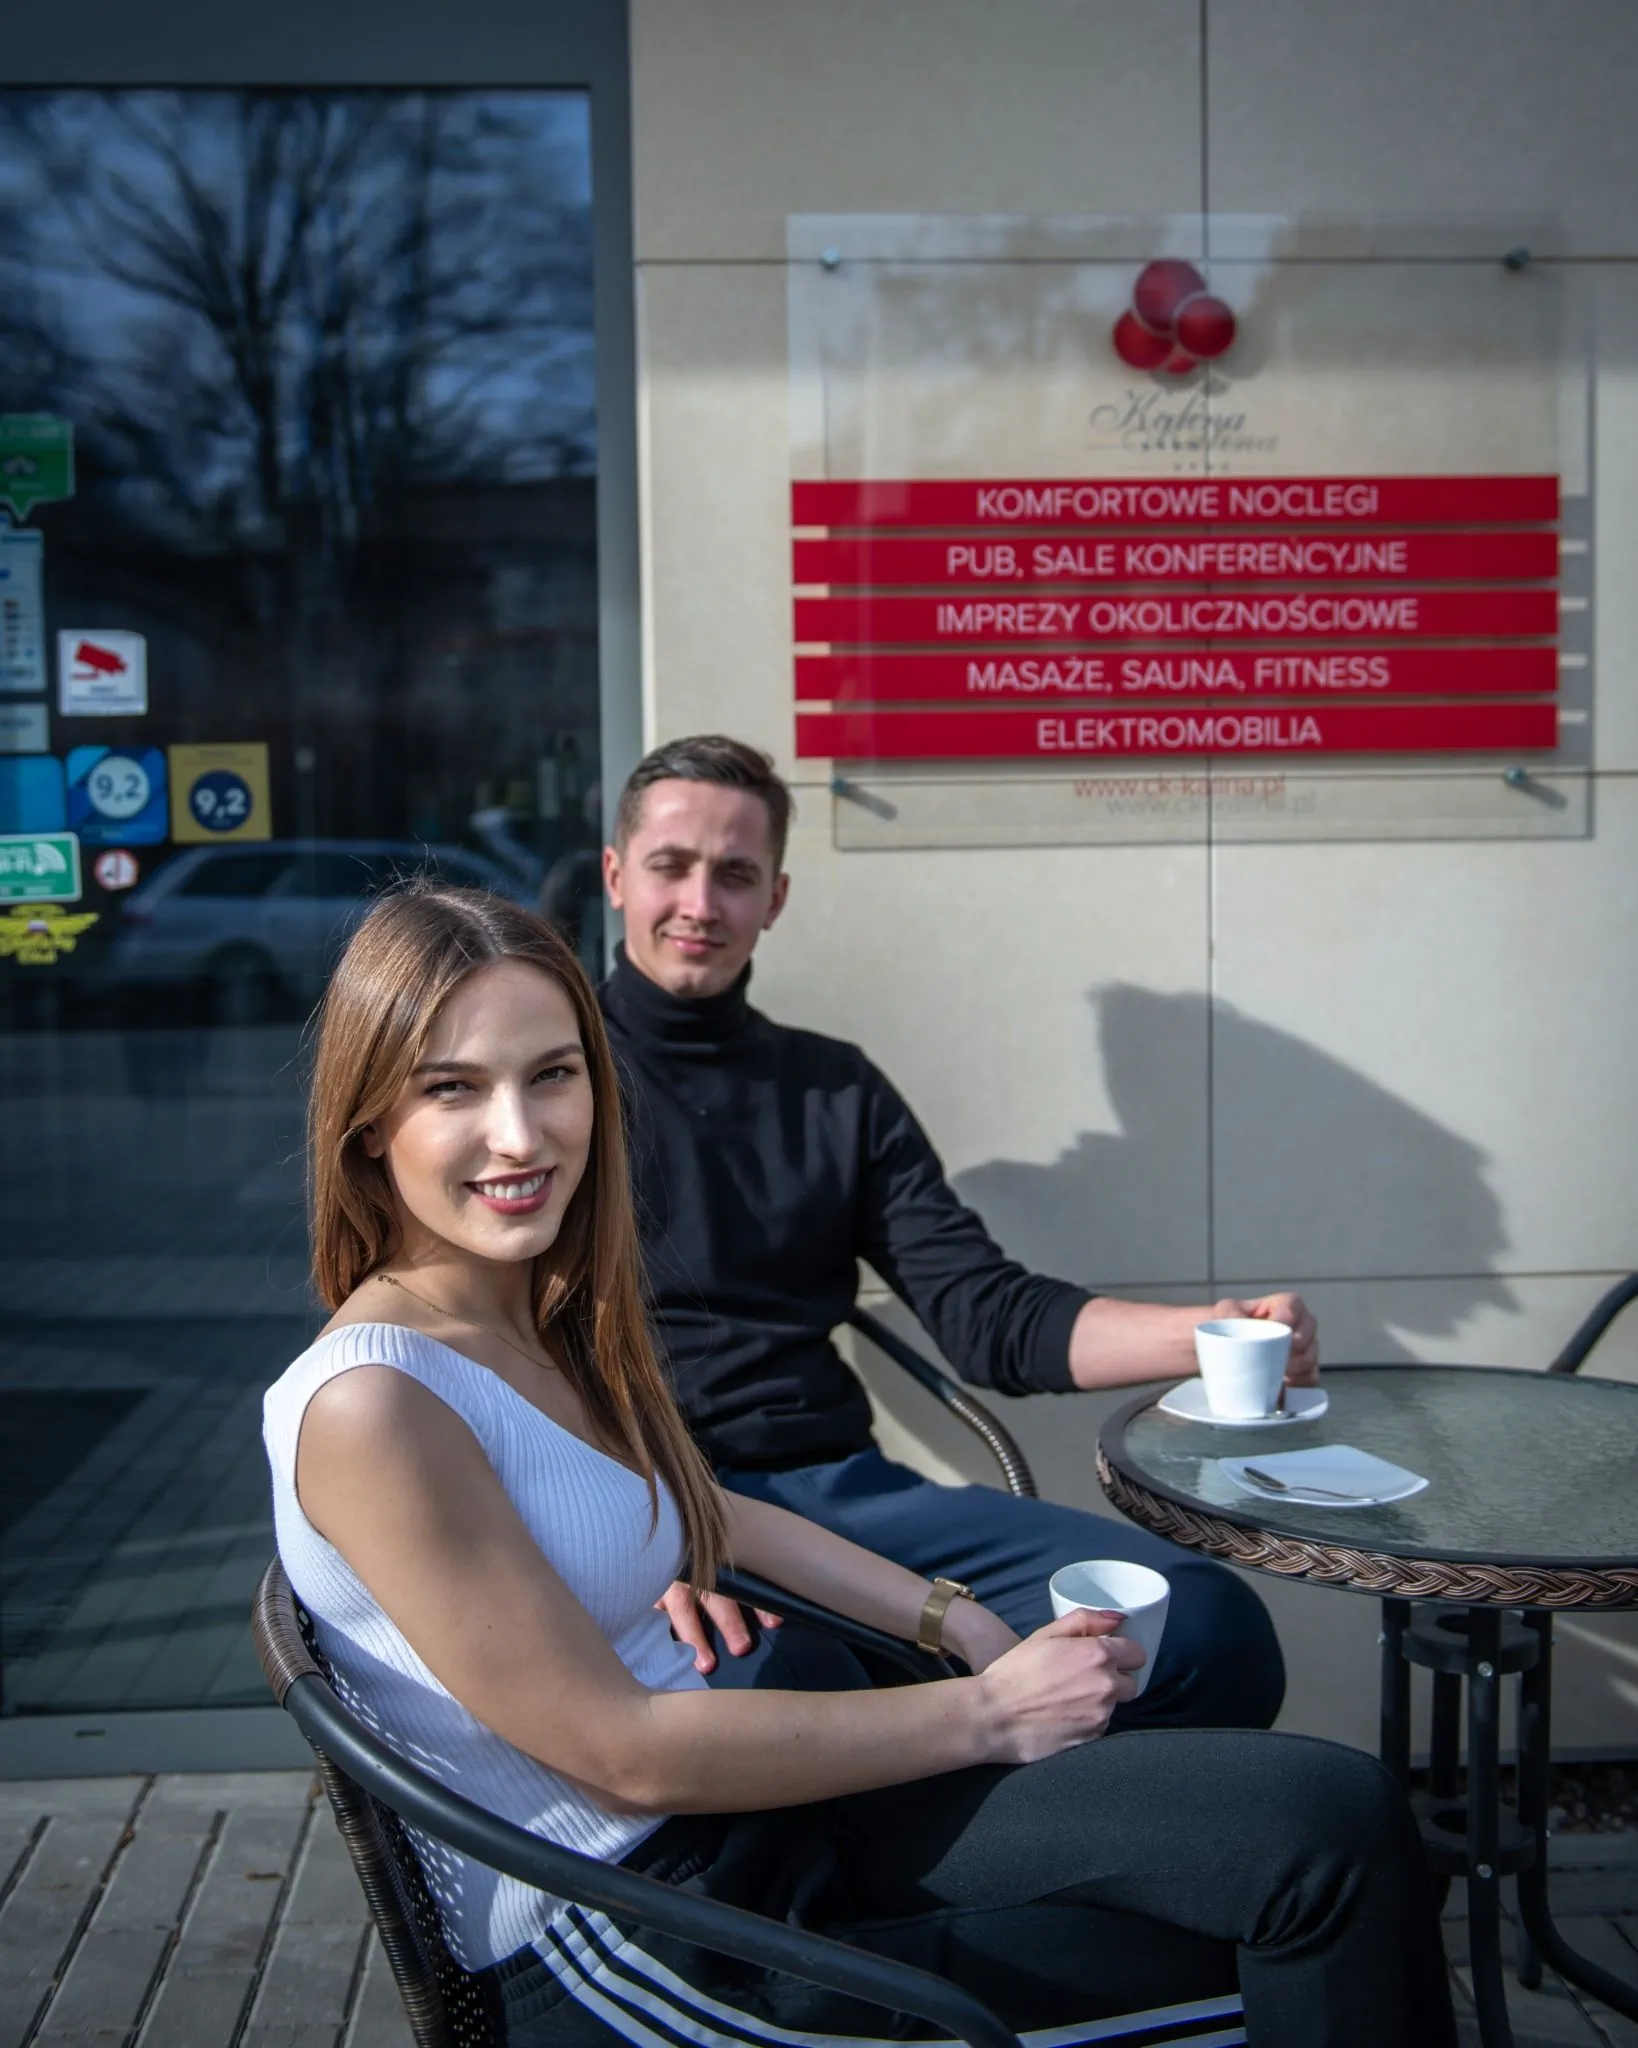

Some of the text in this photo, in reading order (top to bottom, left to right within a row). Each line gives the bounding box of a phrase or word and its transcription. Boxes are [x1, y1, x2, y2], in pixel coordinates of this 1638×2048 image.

[976, 485, 1378, 518] KOMFORTOWE NOCLEGI
[947, 541, 1407, 577] PUB, SALE KONFERENCYJNE
[937, 595, 1418, 633] IMPREZY OKOLICZNOŚCIOWE
[967, 656, 1390, 692] MASAŻE, SAUNA, FITNESS
[1037, 717, 1322, 749] ELEKTROMOBILIA
[95, 773, 141, 804] 9,2
[194, 787, 247, 818] 9,2
